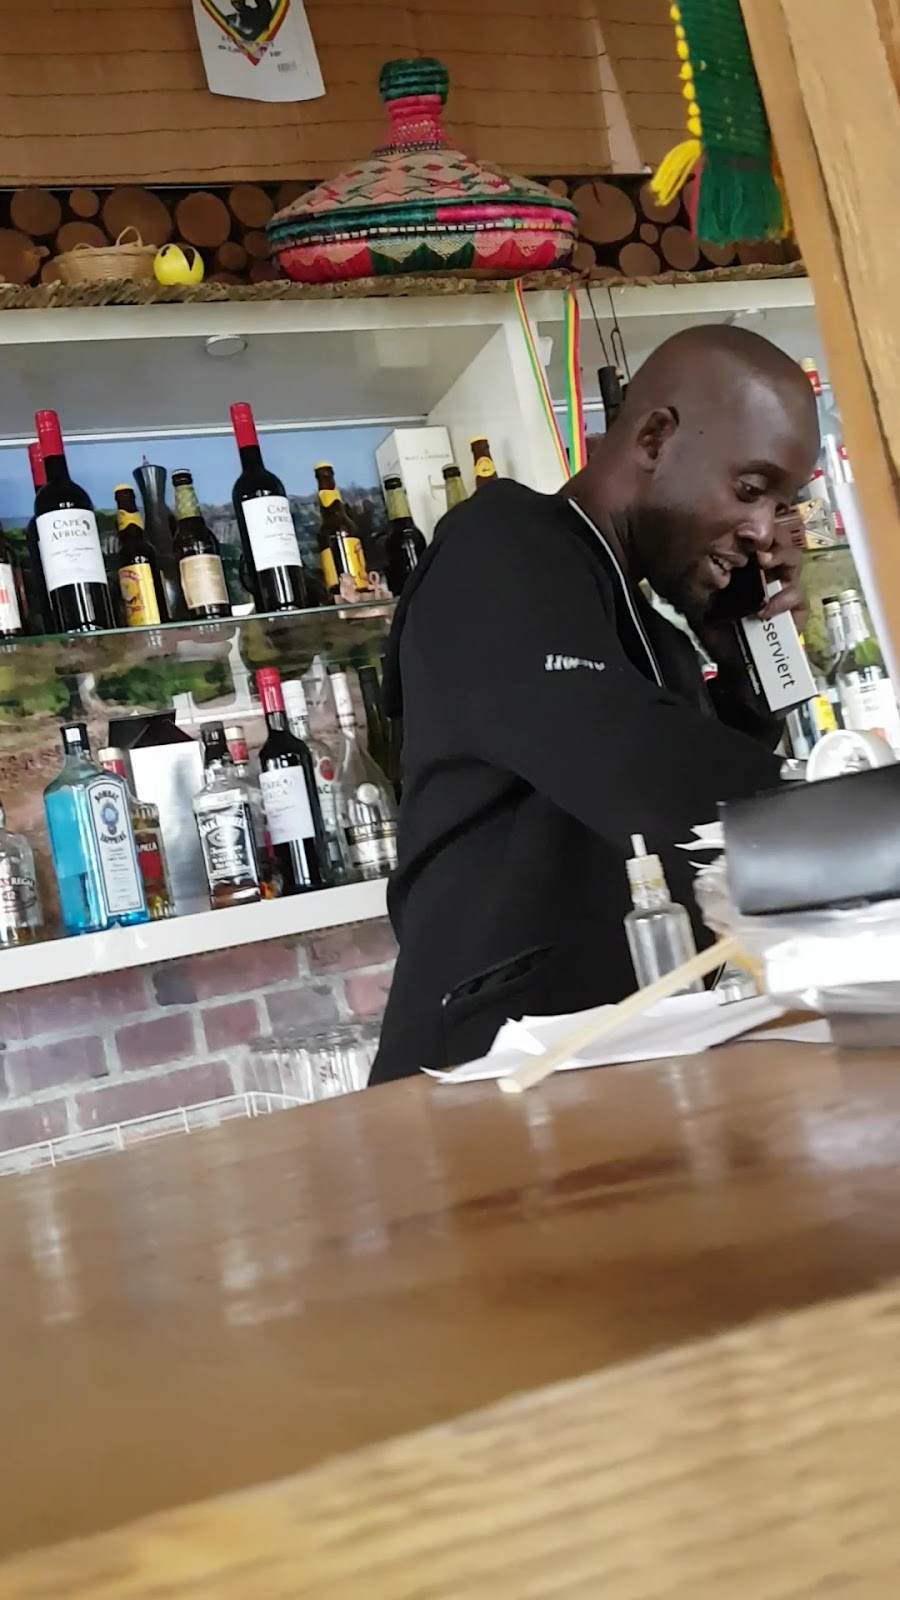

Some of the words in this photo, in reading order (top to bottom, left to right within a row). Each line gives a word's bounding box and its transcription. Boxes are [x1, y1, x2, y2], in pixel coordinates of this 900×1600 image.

[53, 519, 82, 530] CAPE
[51, 529, 88, 542] AFRICA
[761, 618, 796, 690] serviert
